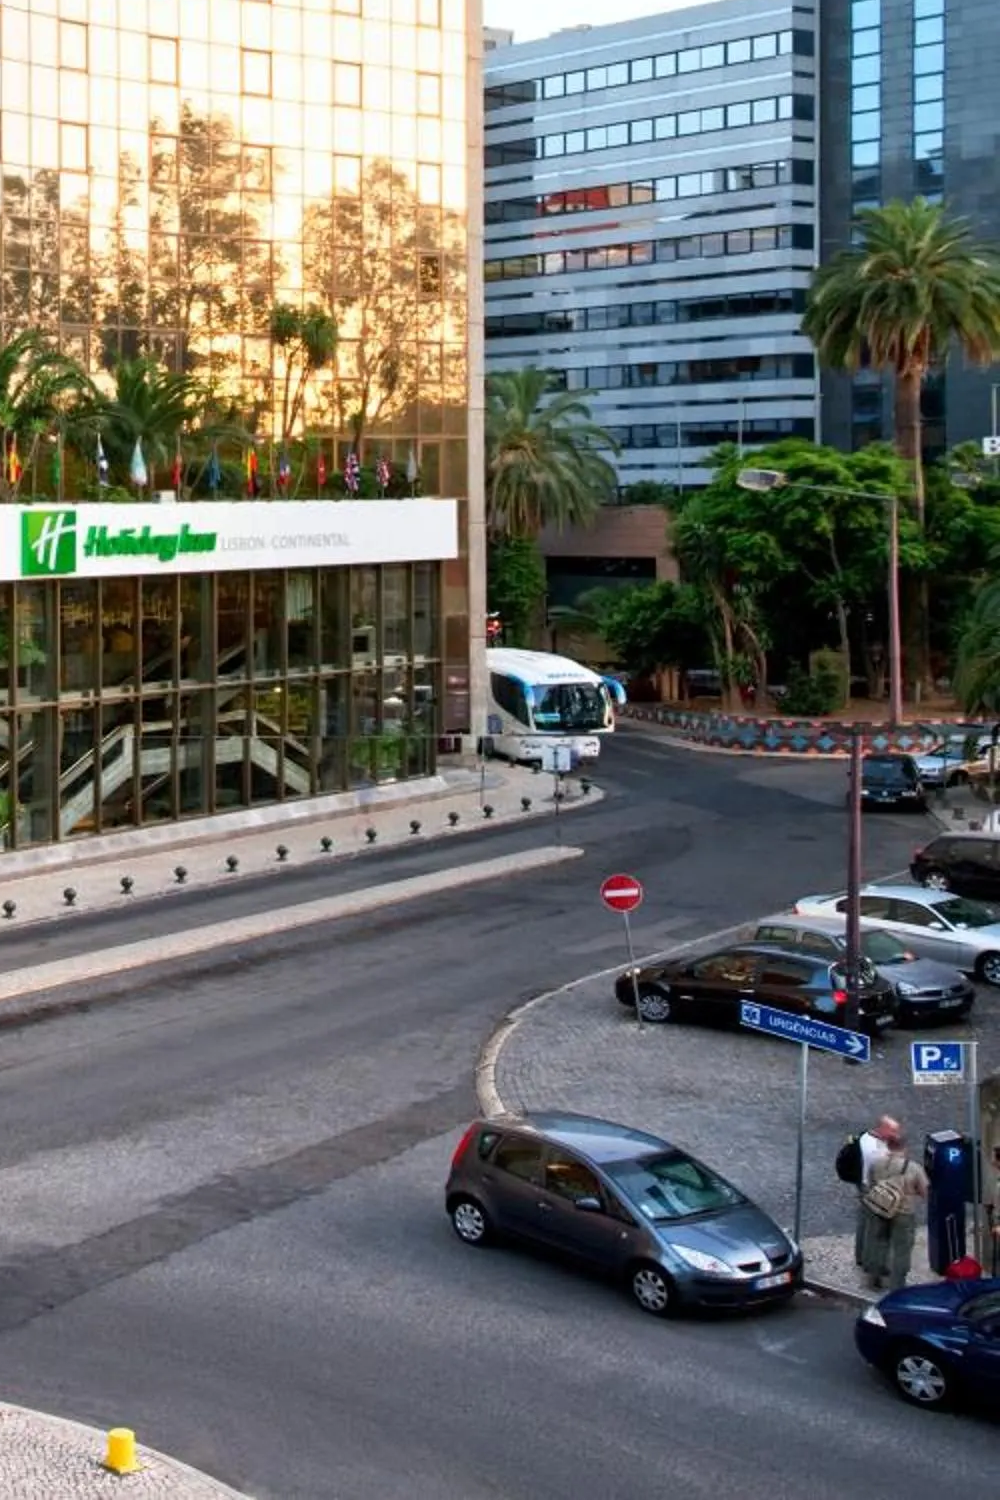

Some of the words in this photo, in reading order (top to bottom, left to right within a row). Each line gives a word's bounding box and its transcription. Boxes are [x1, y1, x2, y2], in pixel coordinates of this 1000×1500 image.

[84, 525, 178, 561] Holiday
[178, 523, 217, 552] Inn
[220, 536, 266, 551] LISBON
[271, 532, 350, 548] CONTINENTAL
[920, 1046, 941, 1069] P
[949, 1147, 960, 1162] P
